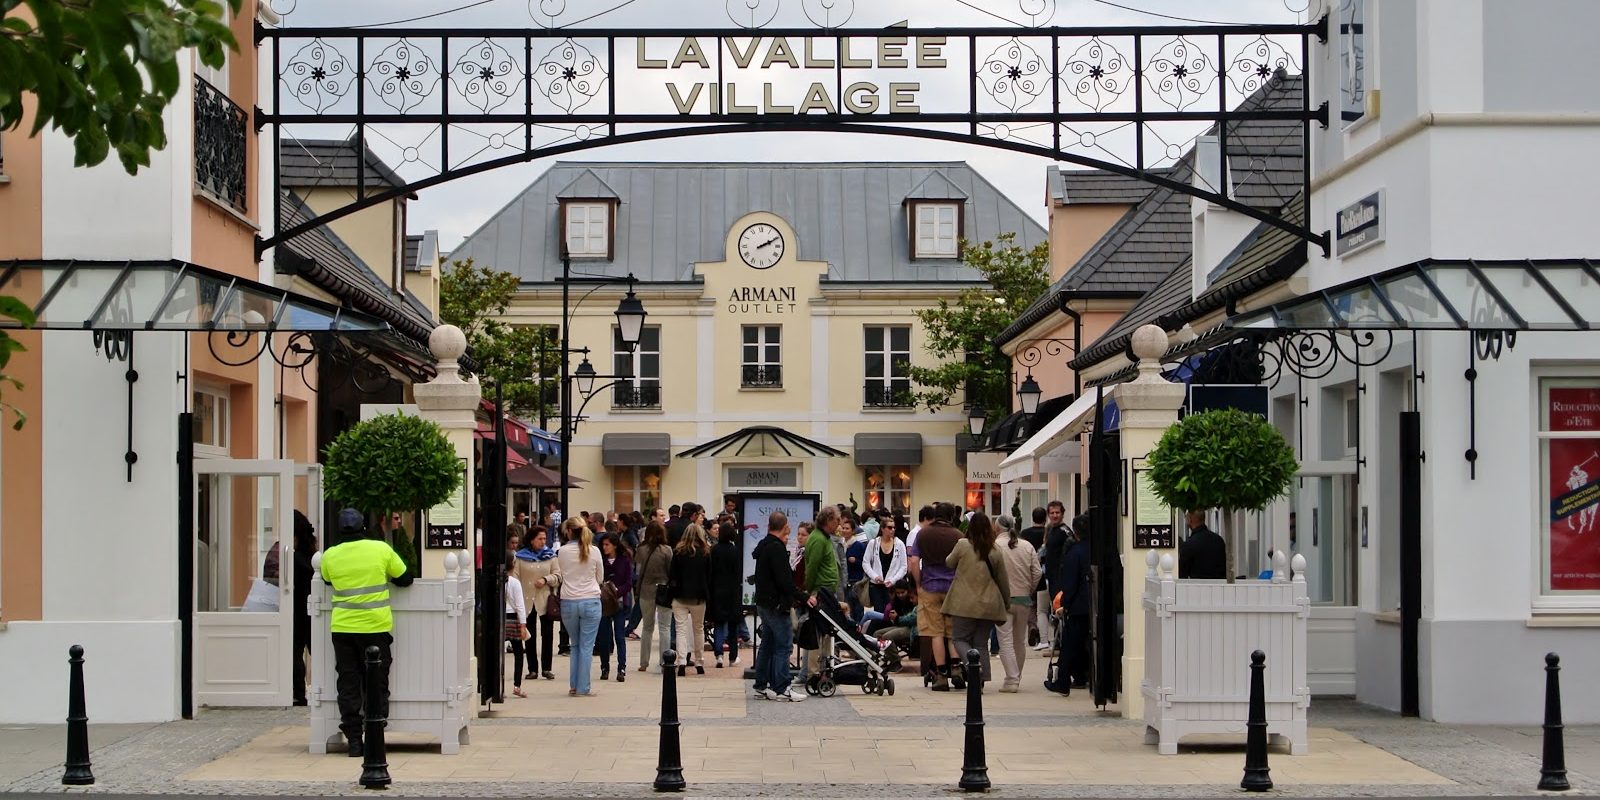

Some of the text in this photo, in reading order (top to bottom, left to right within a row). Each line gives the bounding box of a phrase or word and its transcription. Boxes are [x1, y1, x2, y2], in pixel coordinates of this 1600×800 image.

[637, 36, 709, 69] LA
[665, 82, 920, 114] VILLAGE
[728, 287, 796, 301] ARMANI
[728, 304, 796, 314] OUTLET
[747, 471, 779, 480] ARMANI
